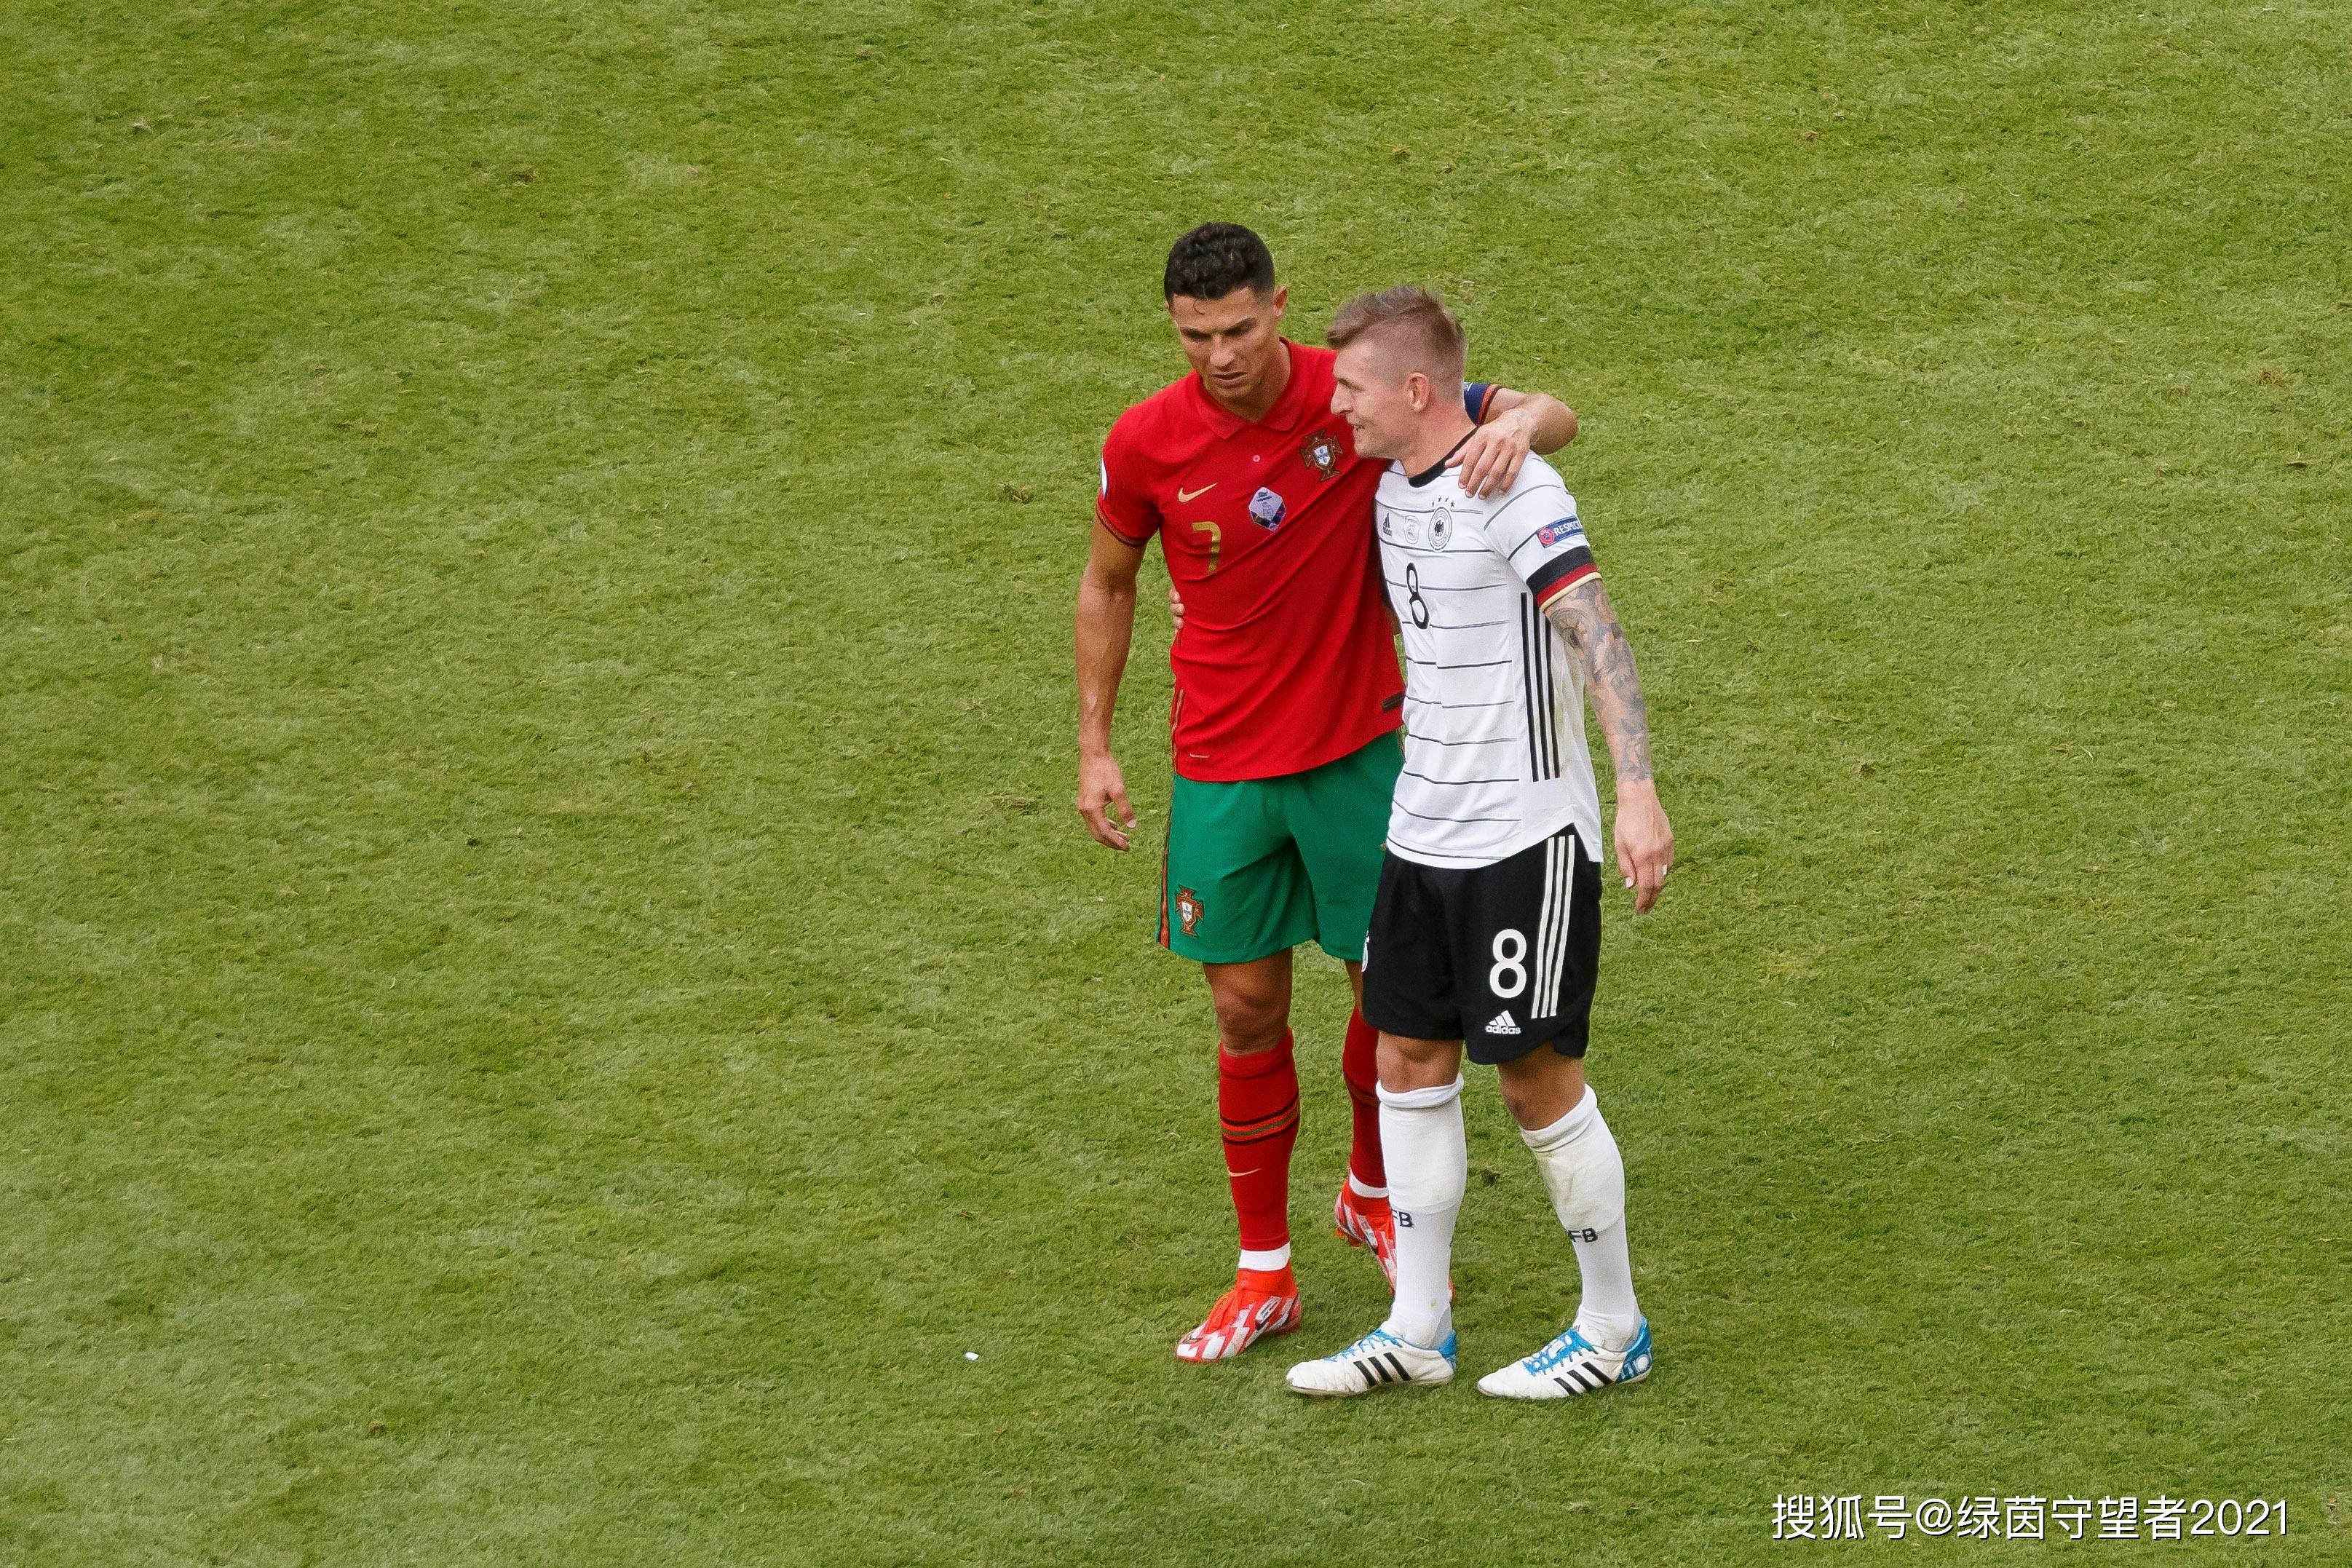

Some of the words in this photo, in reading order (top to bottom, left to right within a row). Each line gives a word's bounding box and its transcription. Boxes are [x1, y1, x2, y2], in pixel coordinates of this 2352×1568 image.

[1192, 520, 1221, 576] 7
[1406, 562, 1430, 630] 8
[1489, 928, 1527, 998] 8
[1485, 1025, 1521, 1034] adidas
